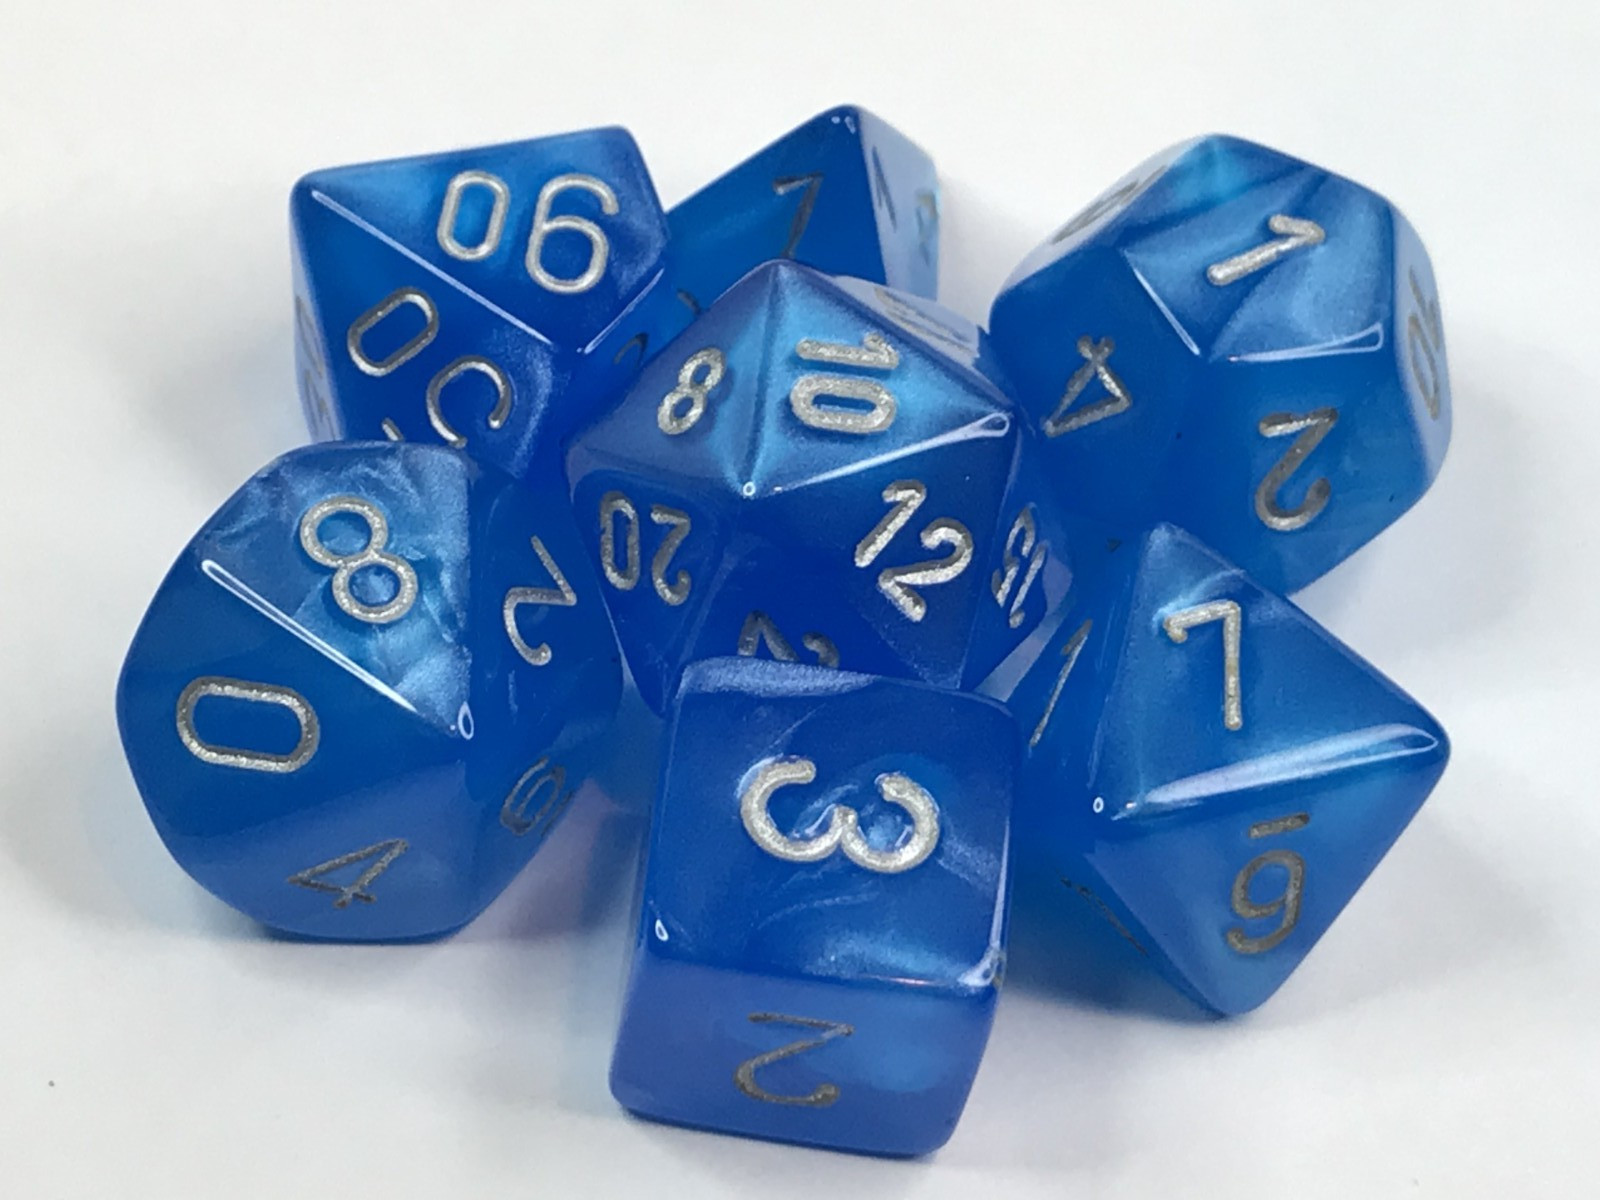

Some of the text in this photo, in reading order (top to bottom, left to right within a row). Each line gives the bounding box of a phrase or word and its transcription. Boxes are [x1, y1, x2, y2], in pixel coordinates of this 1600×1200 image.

[1207, 213, 1326, 286] 1
[657, 347, 727, 436] 8
[789, 332, 899, 436] 10
[1042, 335, 1133, 438] 4
[1255, 407, 1339, 532] 2
[300, 496, 419, 625] 8
[600, 490, 692, 606] 20
[854, 479, 974, 623] 12
[1163, 599, 1242, 731] 7
[175, 675, 321, 773] 0
[740, 755, 940, 874] 3
[286, 837, 410, 910] 4
[734, 1012, 856, 1108] 2
